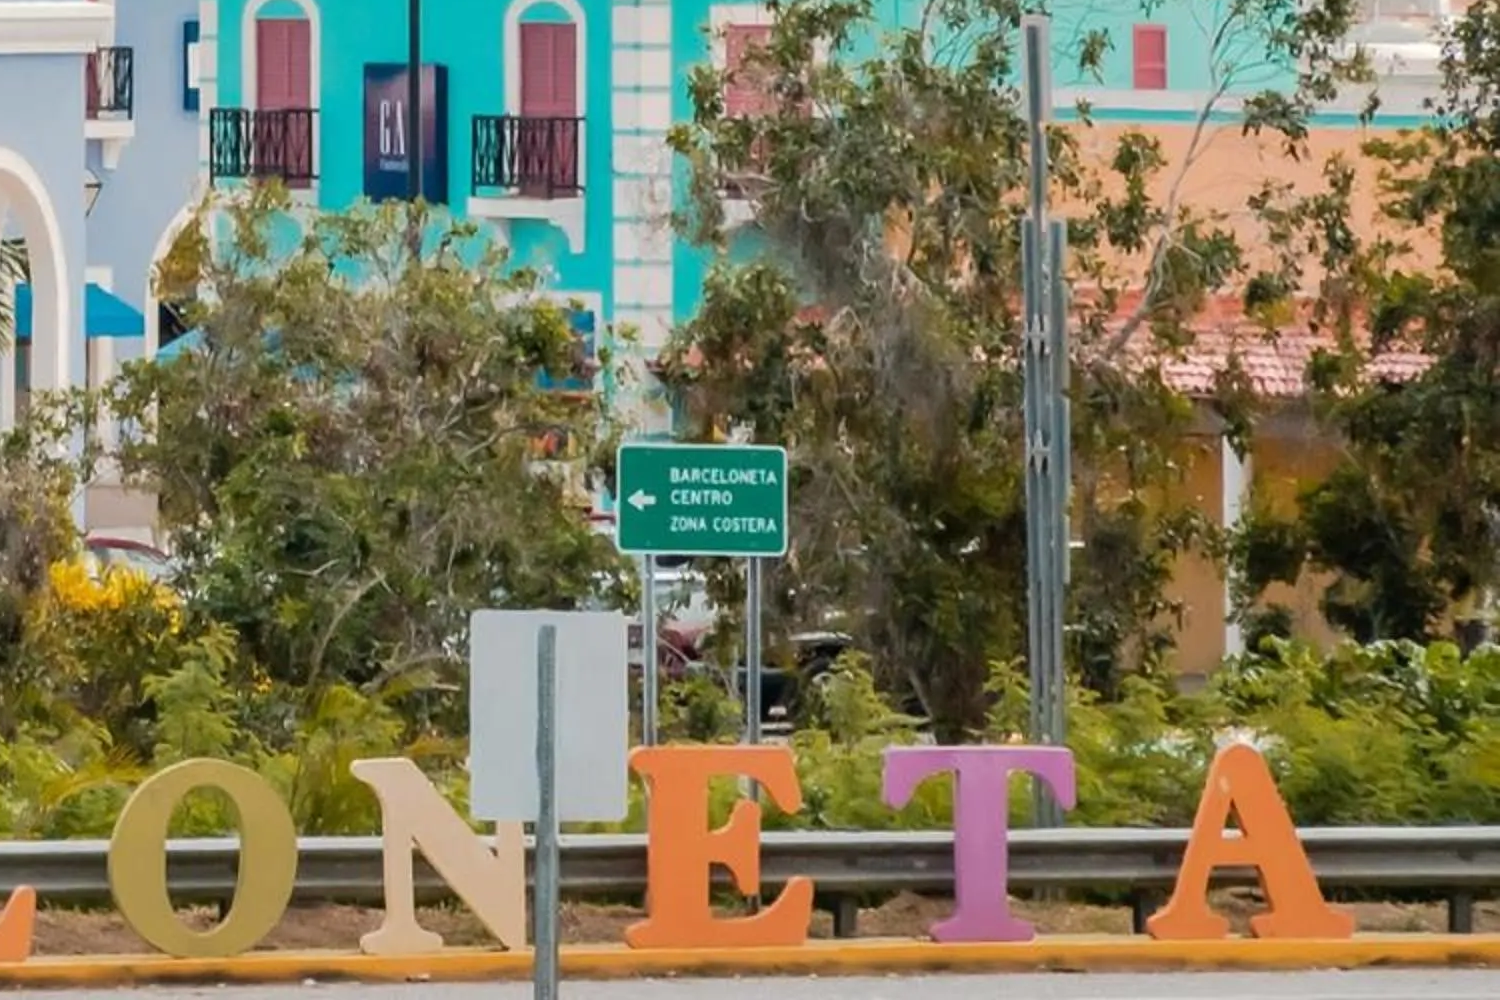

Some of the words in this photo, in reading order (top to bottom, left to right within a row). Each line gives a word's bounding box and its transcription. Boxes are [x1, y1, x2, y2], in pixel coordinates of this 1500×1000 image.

[669, 467, 777, 484] BARCELONETA
[670, 489, 733, 505] CENTRO
[669, 516, 707, 532] ZONA
[712, 517, 777, 533] COSTERA
